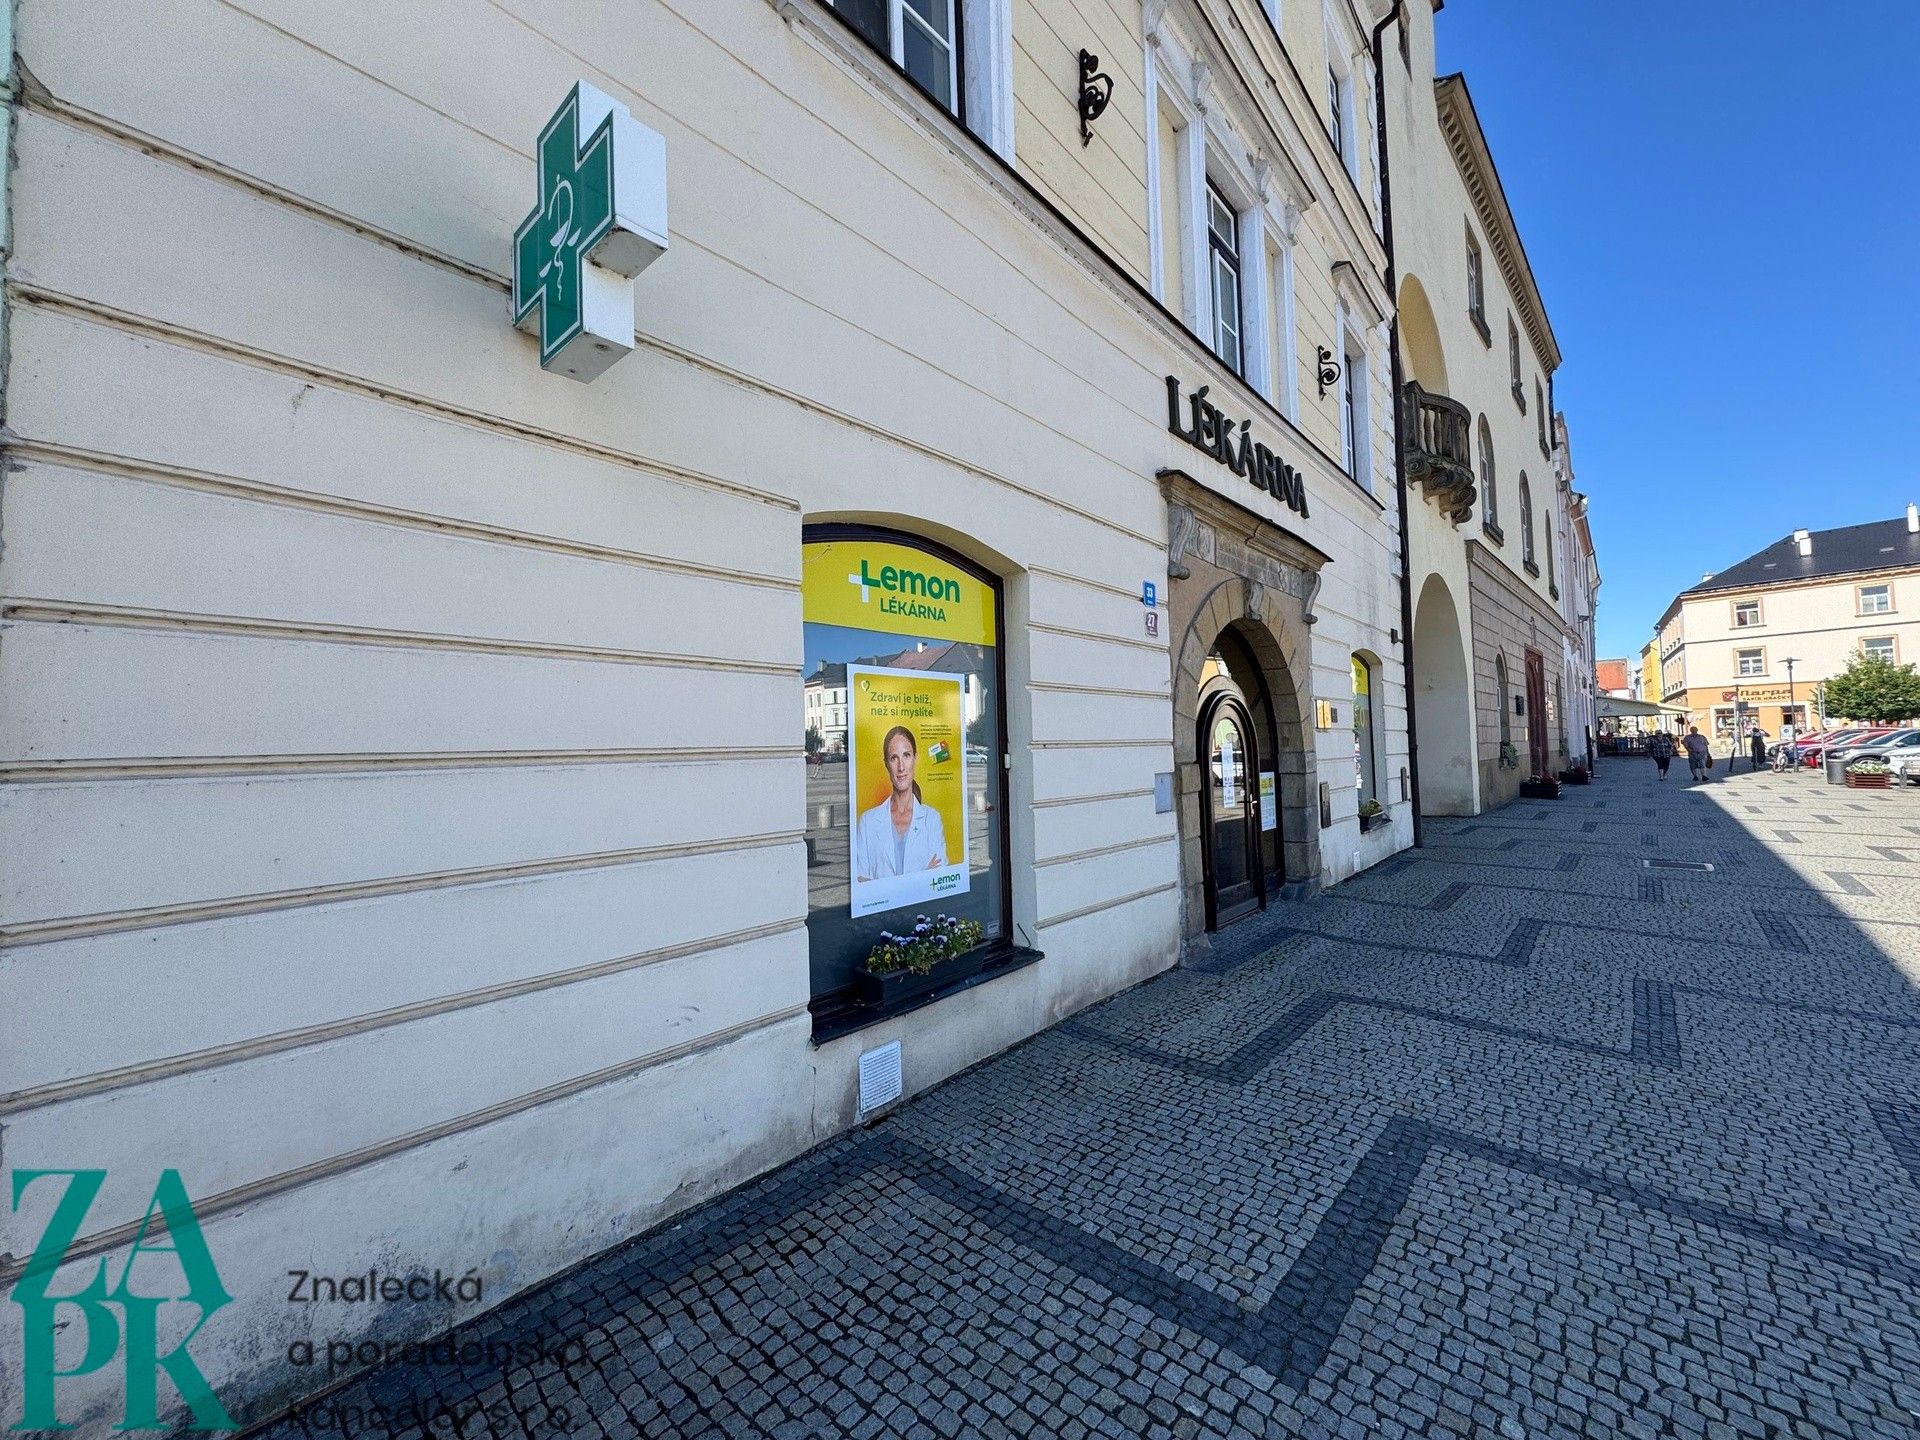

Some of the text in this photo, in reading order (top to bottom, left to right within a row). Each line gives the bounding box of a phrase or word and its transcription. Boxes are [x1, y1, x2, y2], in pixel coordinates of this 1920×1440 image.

[1165, 375, 1310, 519] LÉKÁRNA
[861, 559, 960, 603] Lemon
[880, 596, 946, 622] LÉKÁRNA
[1147, 614, 1155, 627] 27
[903, 693, 912, 705] je
[870, 705, 934, 718] než si myslíte
[932, 873, 961, 886] Lemon
[937, 883, 957, 892] LÉKÁRNA
